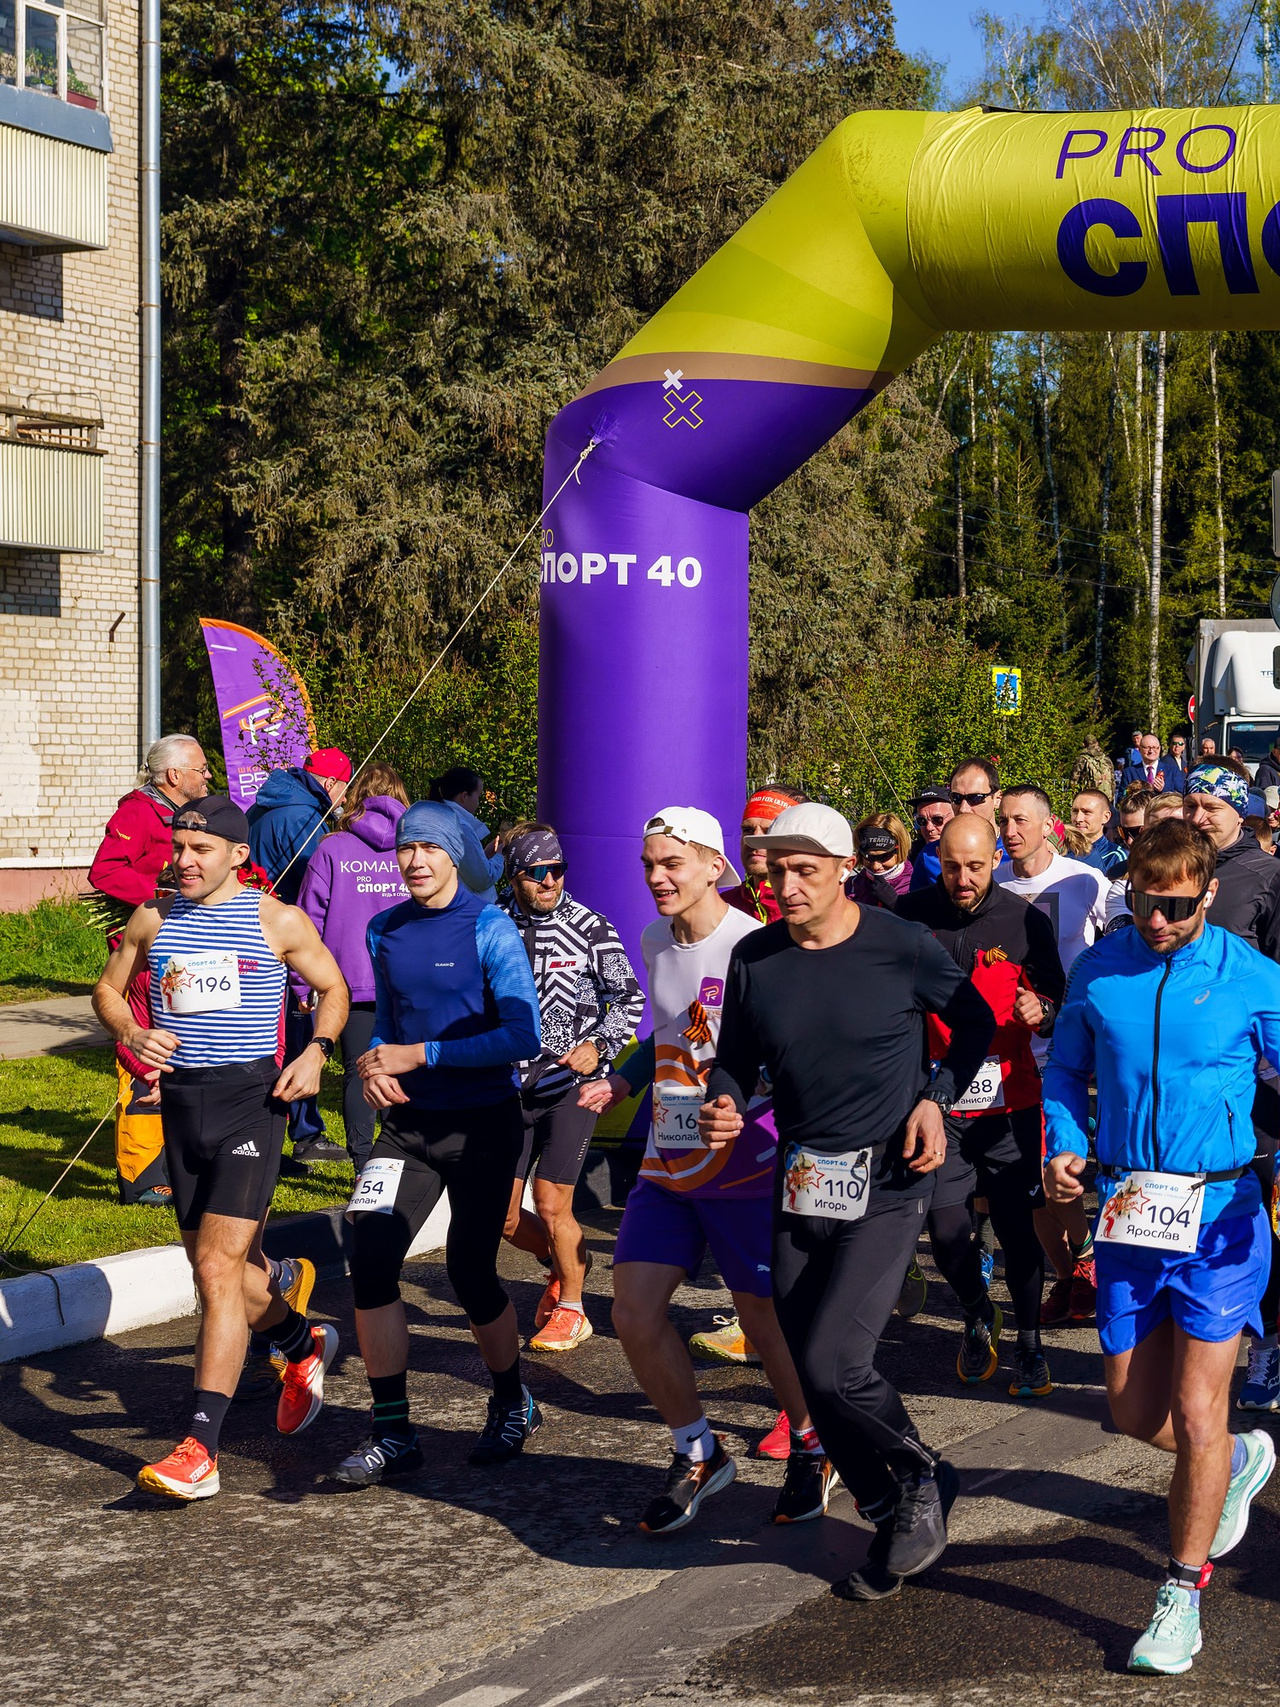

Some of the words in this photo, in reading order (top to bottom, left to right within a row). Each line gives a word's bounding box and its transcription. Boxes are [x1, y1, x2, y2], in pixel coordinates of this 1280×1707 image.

[1055, 124, 1236, 180] PRO
[647, 555, 702, 588] 40
[340, 860, 400, 873] КОМАН
[357, 883, 397, 893] СПОРТ
[195, 975, 231, 993] 196
[658, 1130, 700, 1142] Николай
[232, 1148, 260, 1157] adidas
[360, 1180, 384, 1195] 54
[825, 1179, 860, 1199] 110
[1144, 1182, 1169, 1191] СПОРТ
[814, 1198, 848, 1212] Игорь
[1147, 1204, 1191, 1228] 104
[1126, 1224, 1180, 1241] Ярослав
